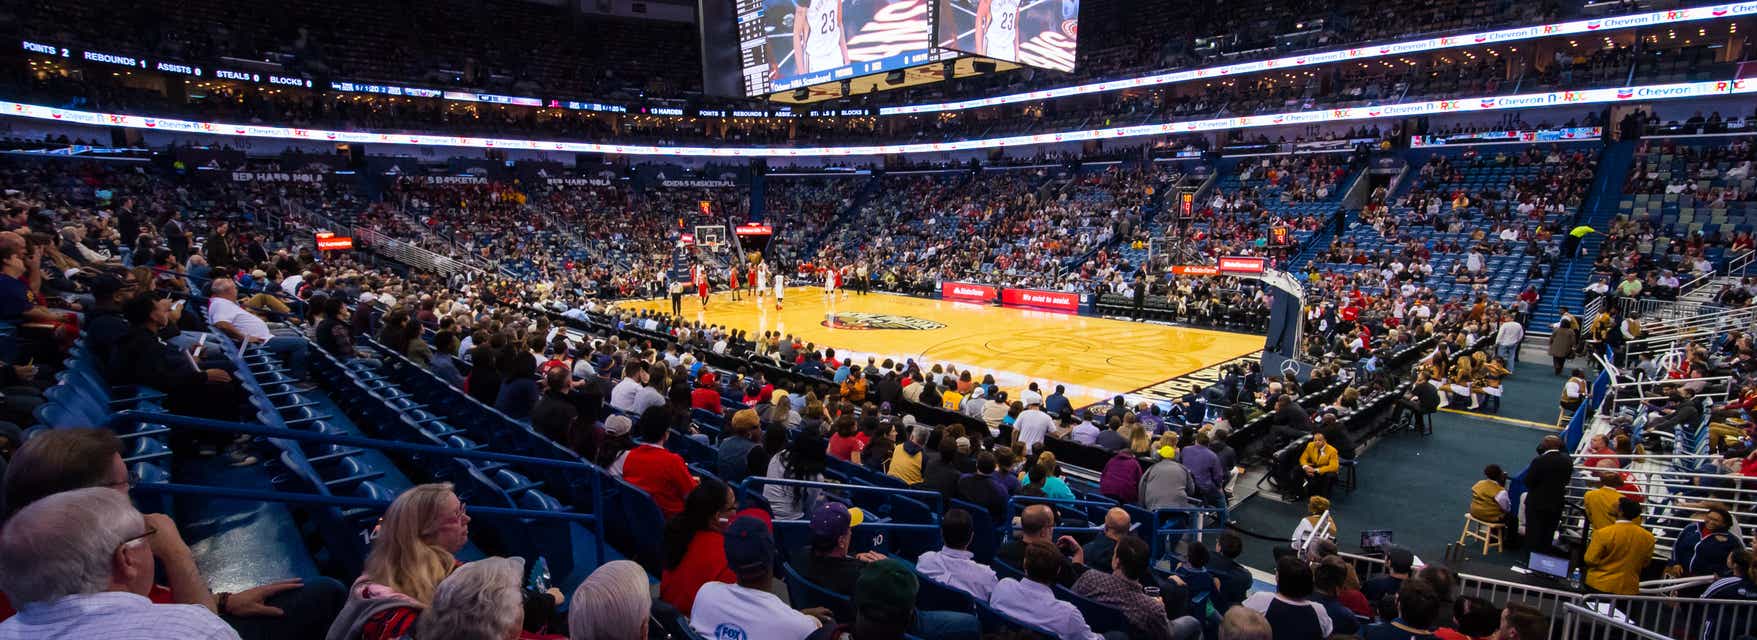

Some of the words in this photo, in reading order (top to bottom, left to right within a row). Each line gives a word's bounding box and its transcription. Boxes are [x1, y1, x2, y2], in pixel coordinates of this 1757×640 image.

[821, 10, 835, 35] 23
[1000, 12, 1014, 31] 23
[1604, 16, 1649, 28] Chevron
[1489, 29, 1528, 41] Chevron
[1392, 41, 1428, 53] Chevron
[1307, 51, 1338, 63] Chevron
[23, 40, 57, 55] POINTS
[61, 48, 70, 58] 2
[84, 50, 136, 67] REBOUNDS
[140, 59, 147, 69] 1
[157, 62, 192, 75] ASSISTS
[194, 67, 202, 77] 0
[216, 69, 251, 81] STEALS
[253, 74, 260, 82] 0
[269, 75, 303, 88] BLOCKS
[305, 80, 313, 89] 0
[1638, 85, 1692, 98] Chevron
[1498, 96, 1544, 107] Chevron
[659, 108, 683, 116] HARDEN
[1384, 104, 1424, 115] Chevron
[1199, 118, 1228, 128] Chevron
[1285, 112, 1320, 123] Chevron
[158, 120, 192, 130] Chevron
[872, 534, 884, 546] 10
[722, 627, 740, 640] FOX
